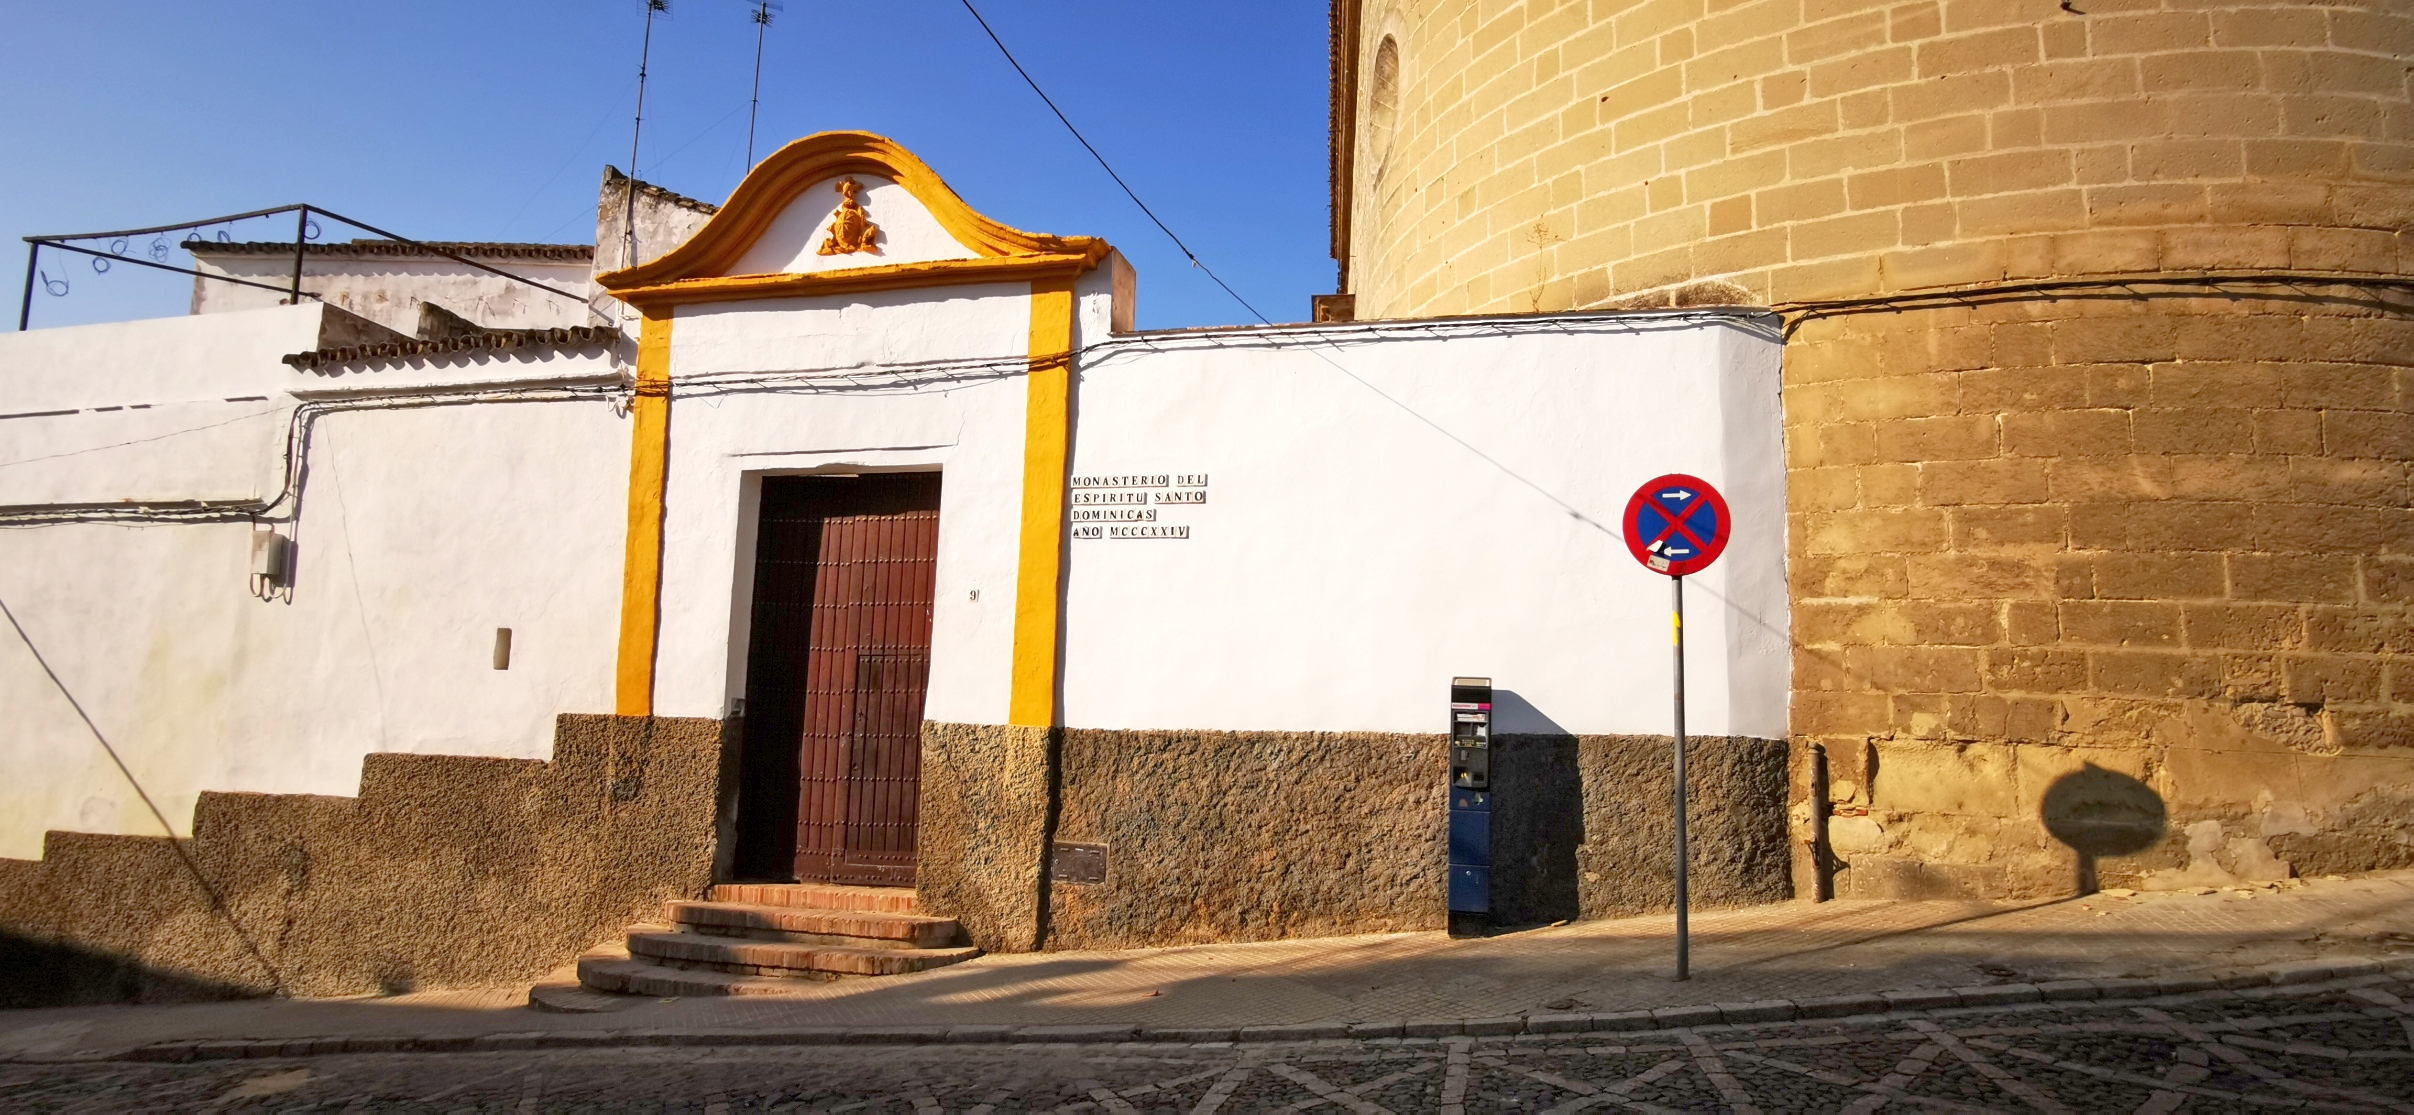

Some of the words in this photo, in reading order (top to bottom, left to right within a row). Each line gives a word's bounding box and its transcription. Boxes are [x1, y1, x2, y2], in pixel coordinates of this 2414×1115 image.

[1072, 475, 1166, 486] MONASTERIO
[1177, 474, 1204, 484] DEL
[1074, 493, 1143, 503] ESPIRITU
[1155, 491, 1203, 502] SANTO
[1073, 509, 1153, 520] DOMINICAS
[1073, 526, 1100, 537] AÑO
[1110, 526, 1185, 537] MCCCXXIV
[969, 589, 976, 601] 9
